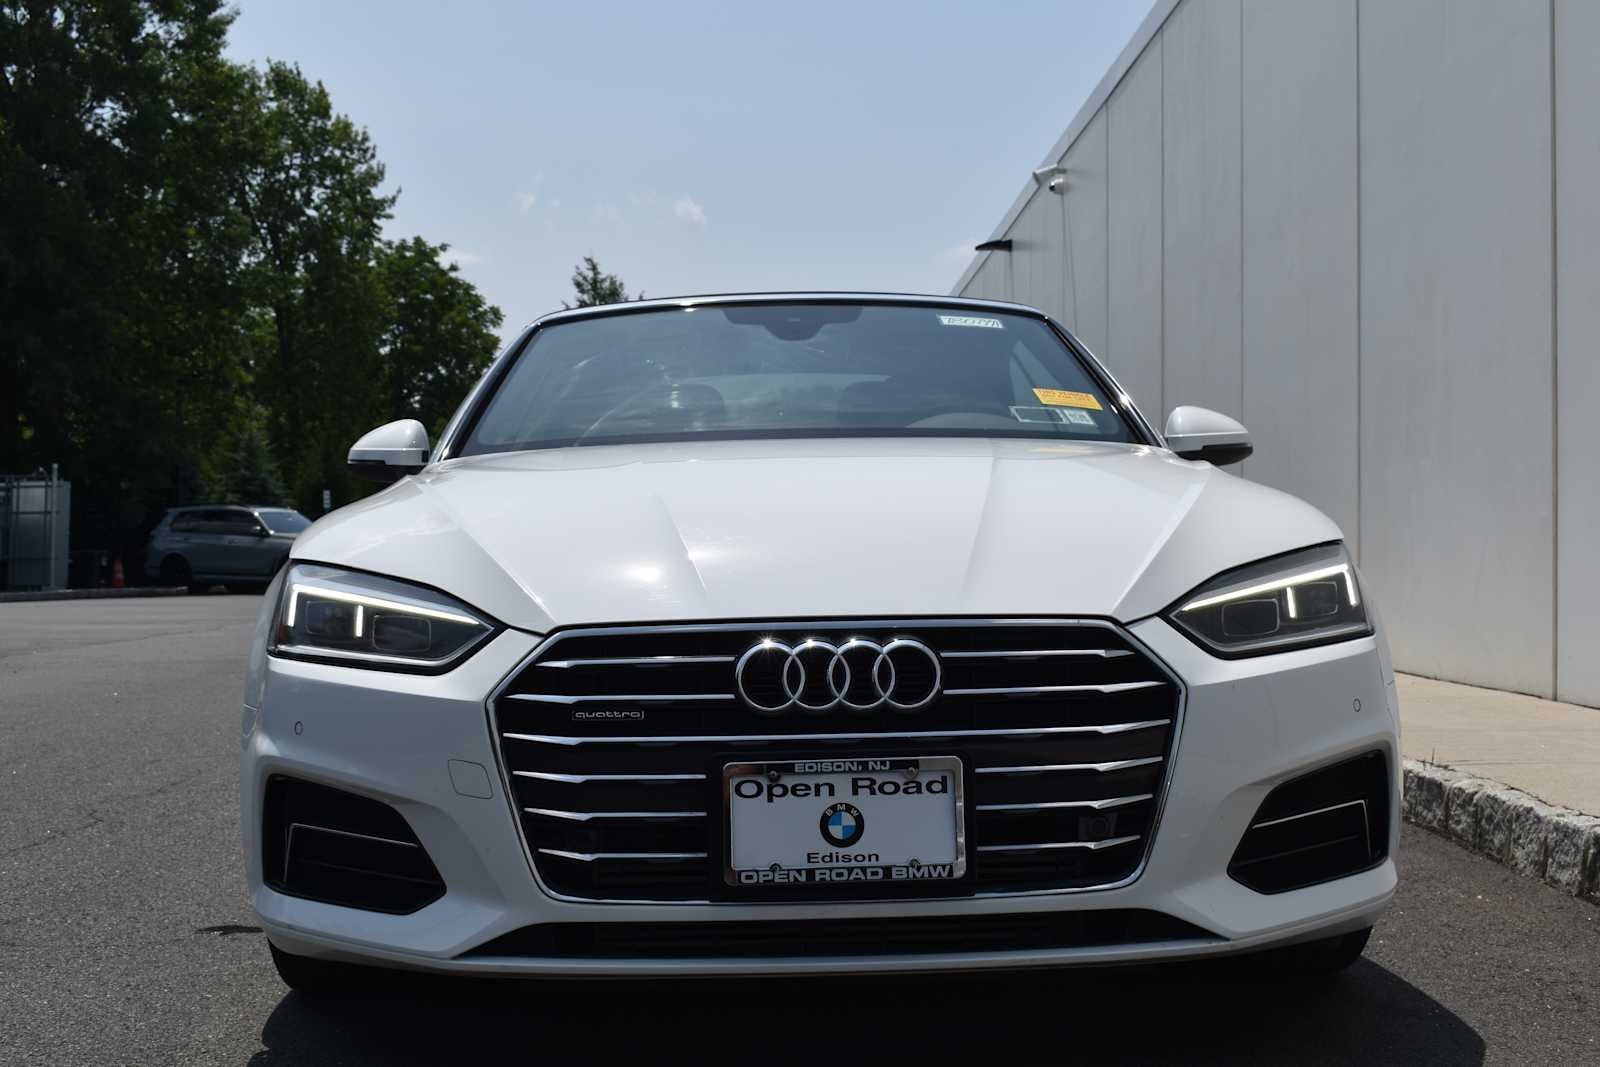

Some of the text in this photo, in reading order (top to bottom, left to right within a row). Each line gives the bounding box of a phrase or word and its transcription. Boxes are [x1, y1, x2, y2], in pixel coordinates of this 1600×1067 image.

[575, 711, 641, 719] quattro
[794, 760, 891, 774] EDISON, NJ
[734, 775, 949, 803] Open Road
[825, 804, 860, 817] BMW
[806, 851, 880, 864] Edison
[740, 865, 951, 884] OPEN ROAD BMW
